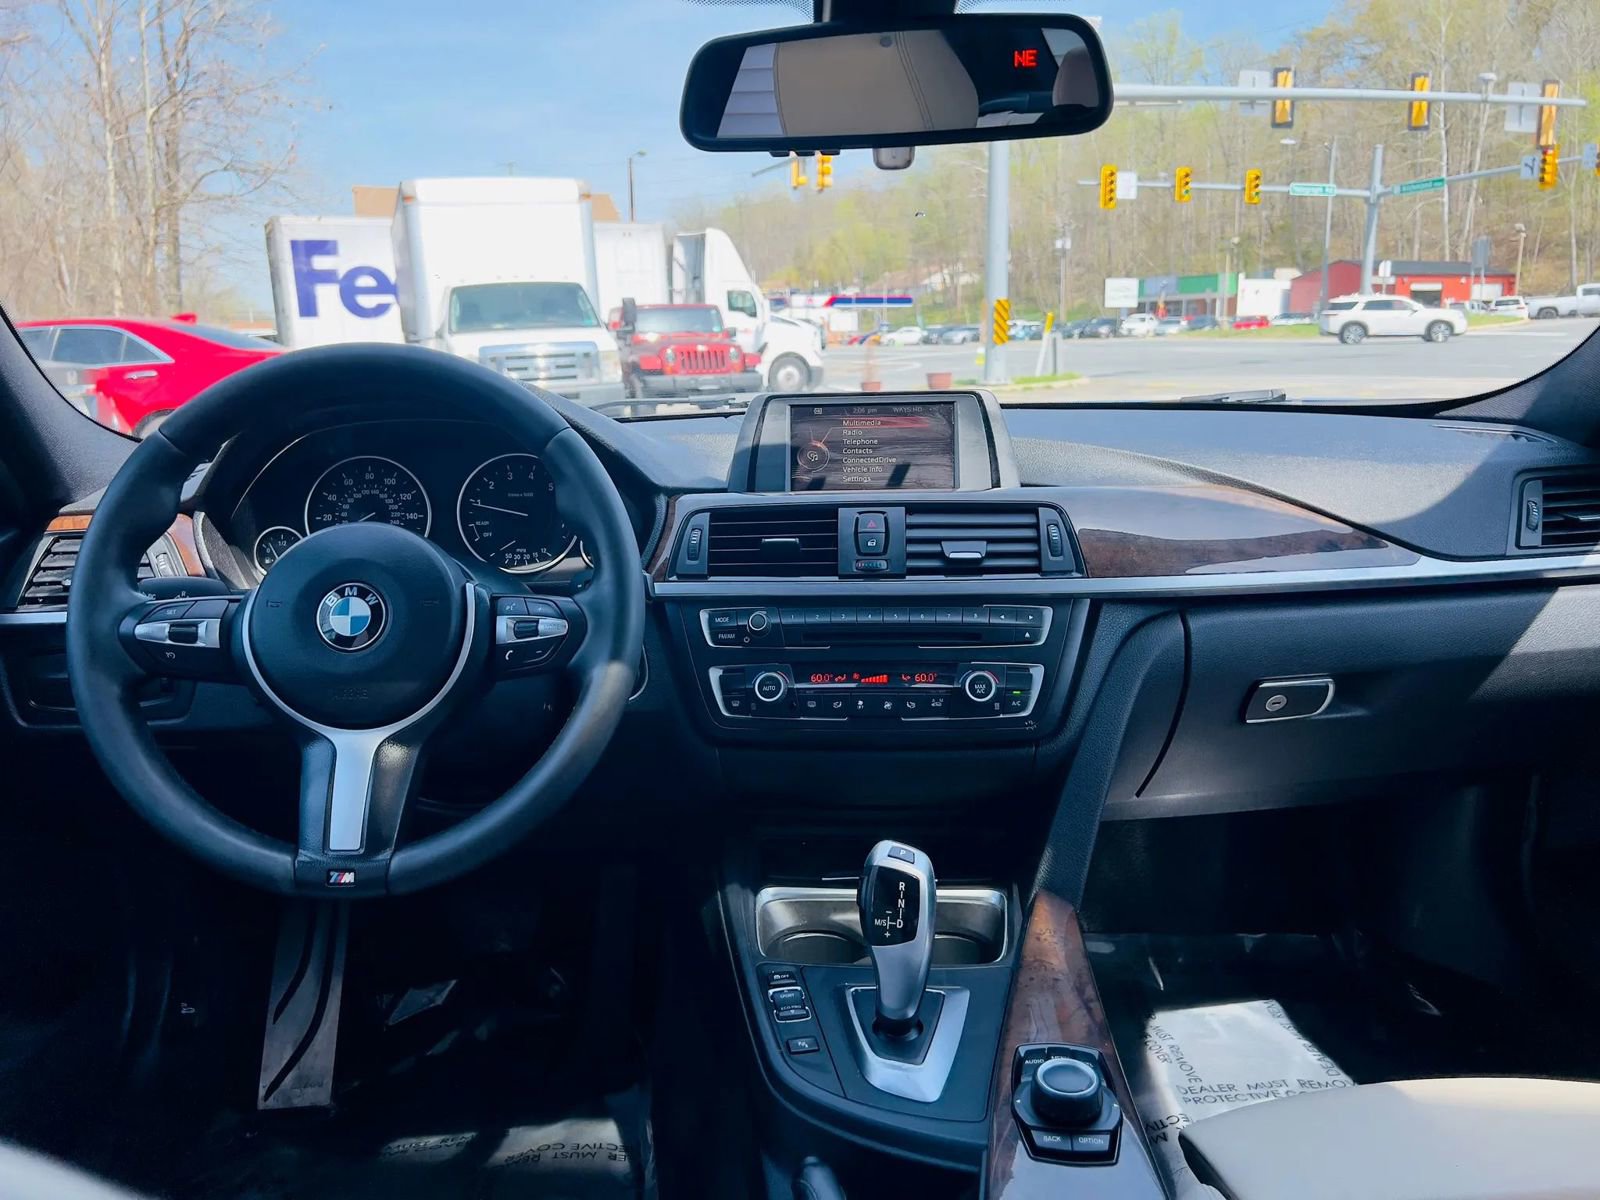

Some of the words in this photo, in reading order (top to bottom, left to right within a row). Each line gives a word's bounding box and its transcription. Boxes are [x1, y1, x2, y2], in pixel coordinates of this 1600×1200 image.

[1014, 49, 1037, 67] NE
[290, 239, 397, 318] Fe
[507, 472, 512, 480] 3
[528, 472, 534, 480] 4
[842, 475, 871, 483] Settings
[489, 481, 494, 489] 2
[548, 483, 554, 491] 5
[325, 586, 378, 607] BMW
[899, 882, 906, 891] R
[898, 899, 905, 908] N
[874, 918, 887, 927] M/S
[896, 919, 904, 928] D
[1176, 1082, 1238, 1096] DEALER
[1247, 1078, 1290, 1091] MUST
[1182, 1089, 1282, 1106] PROTECTIVE
[1078, 1136, 1104, 1145] OPTION
[552, 1151, 597, 1160] MUST
